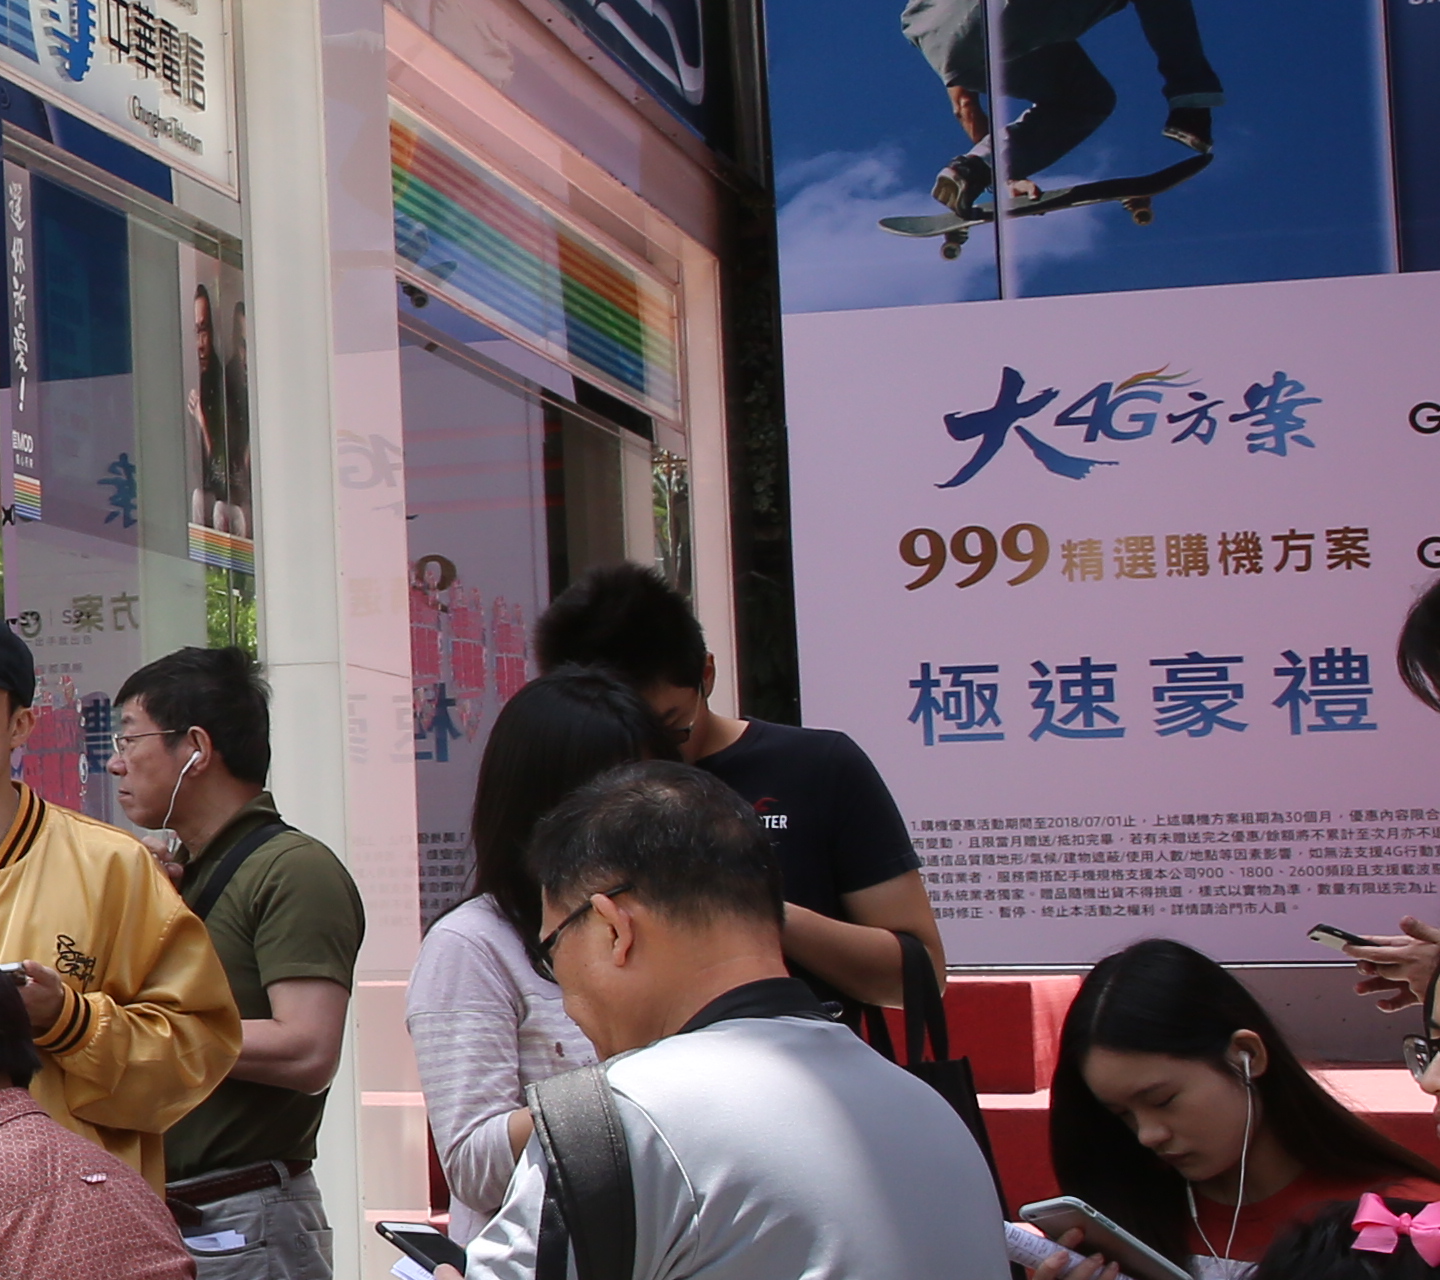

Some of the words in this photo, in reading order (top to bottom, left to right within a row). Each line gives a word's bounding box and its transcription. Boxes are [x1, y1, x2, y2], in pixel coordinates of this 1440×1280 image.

[933, 363, 1323, 489] 大4G方案
[907, 646, 1378, 747] 極速豪禮
